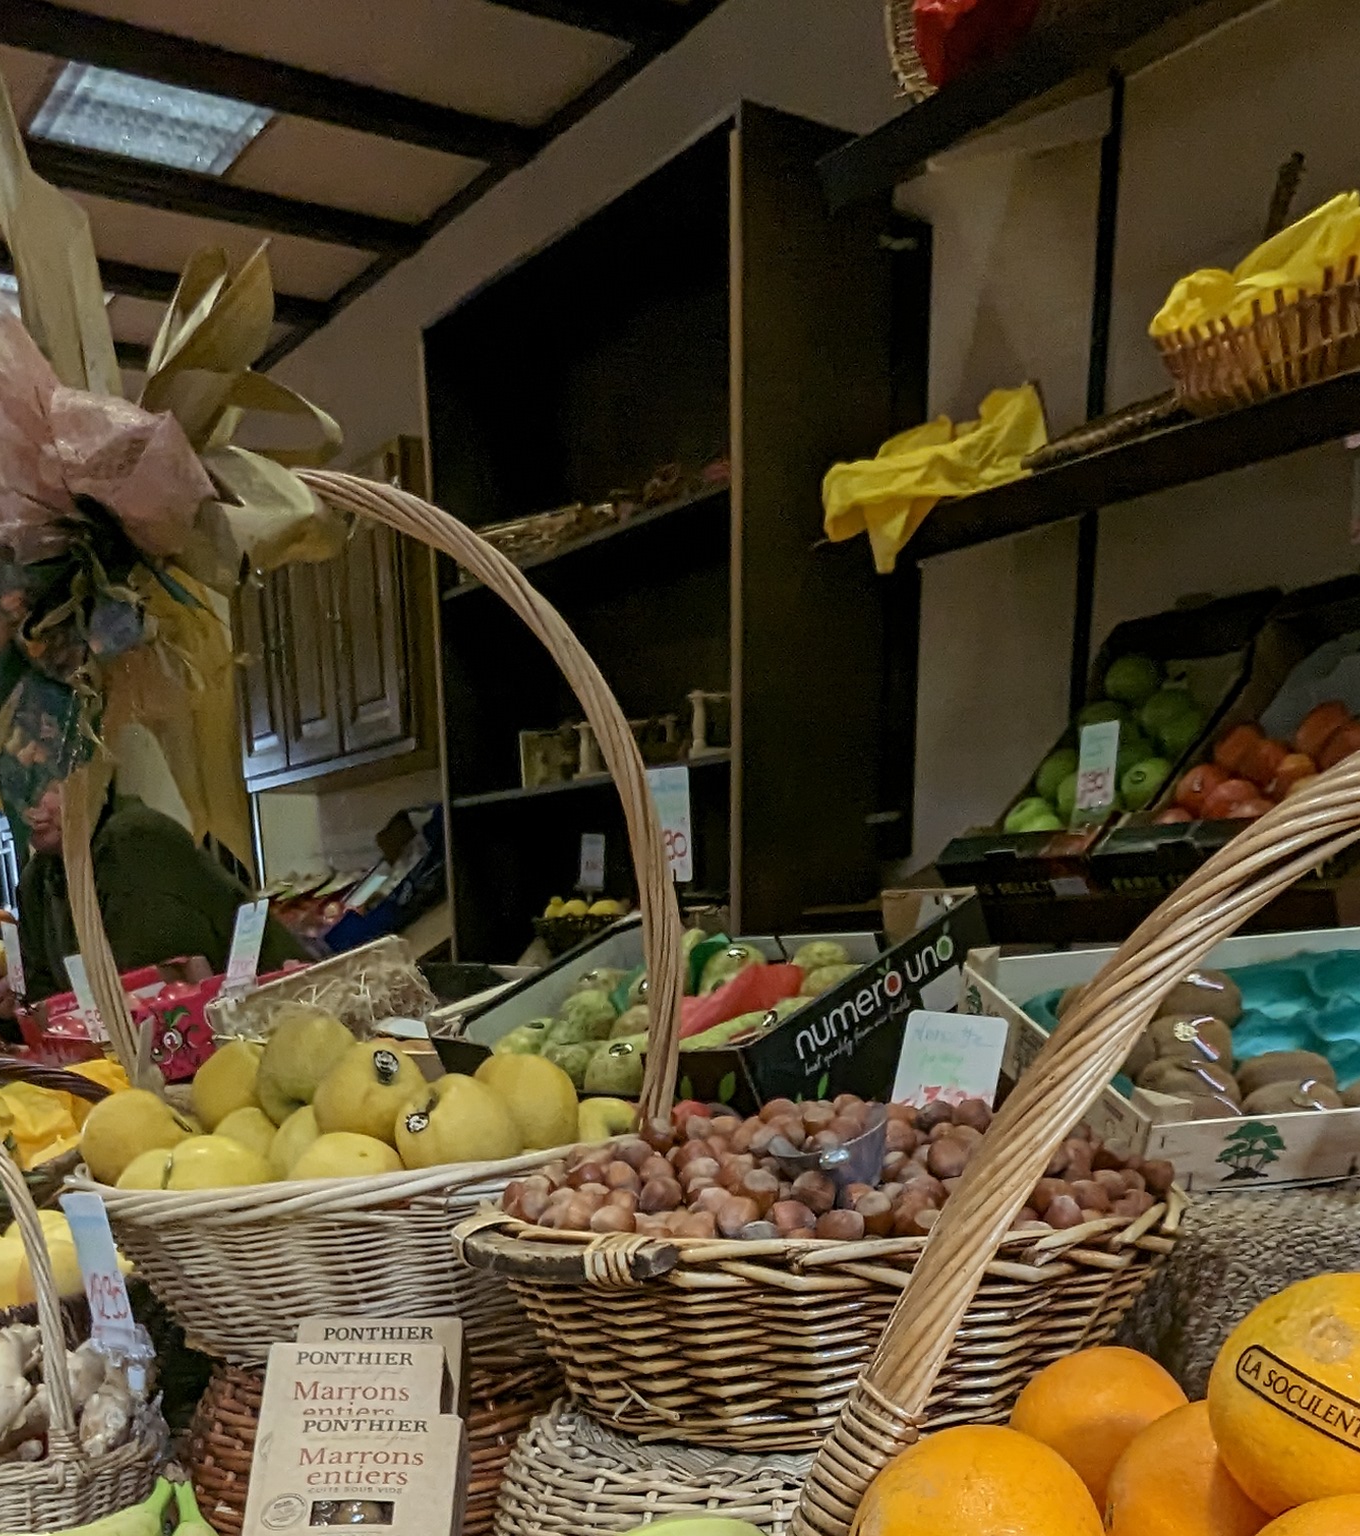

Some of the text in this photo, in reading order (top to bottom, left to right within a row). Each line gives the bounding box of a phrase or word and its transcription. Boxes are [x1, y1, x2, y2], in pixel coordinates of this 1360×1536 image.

[905, 935, 954, 983] uno
[324, 1326, 434, 1341] PONTHIER
[296, 1350, 414, 1366] PONTHIER
[1241, 1354, 1262, 1381] LA
[293, 1380, 411, 1402] Marrons
[302, 1419, 429, 1434] PONTHIER
[298, 1447, 425, 1467] Marrons
[306, 1465, 409, 1486] entiers
